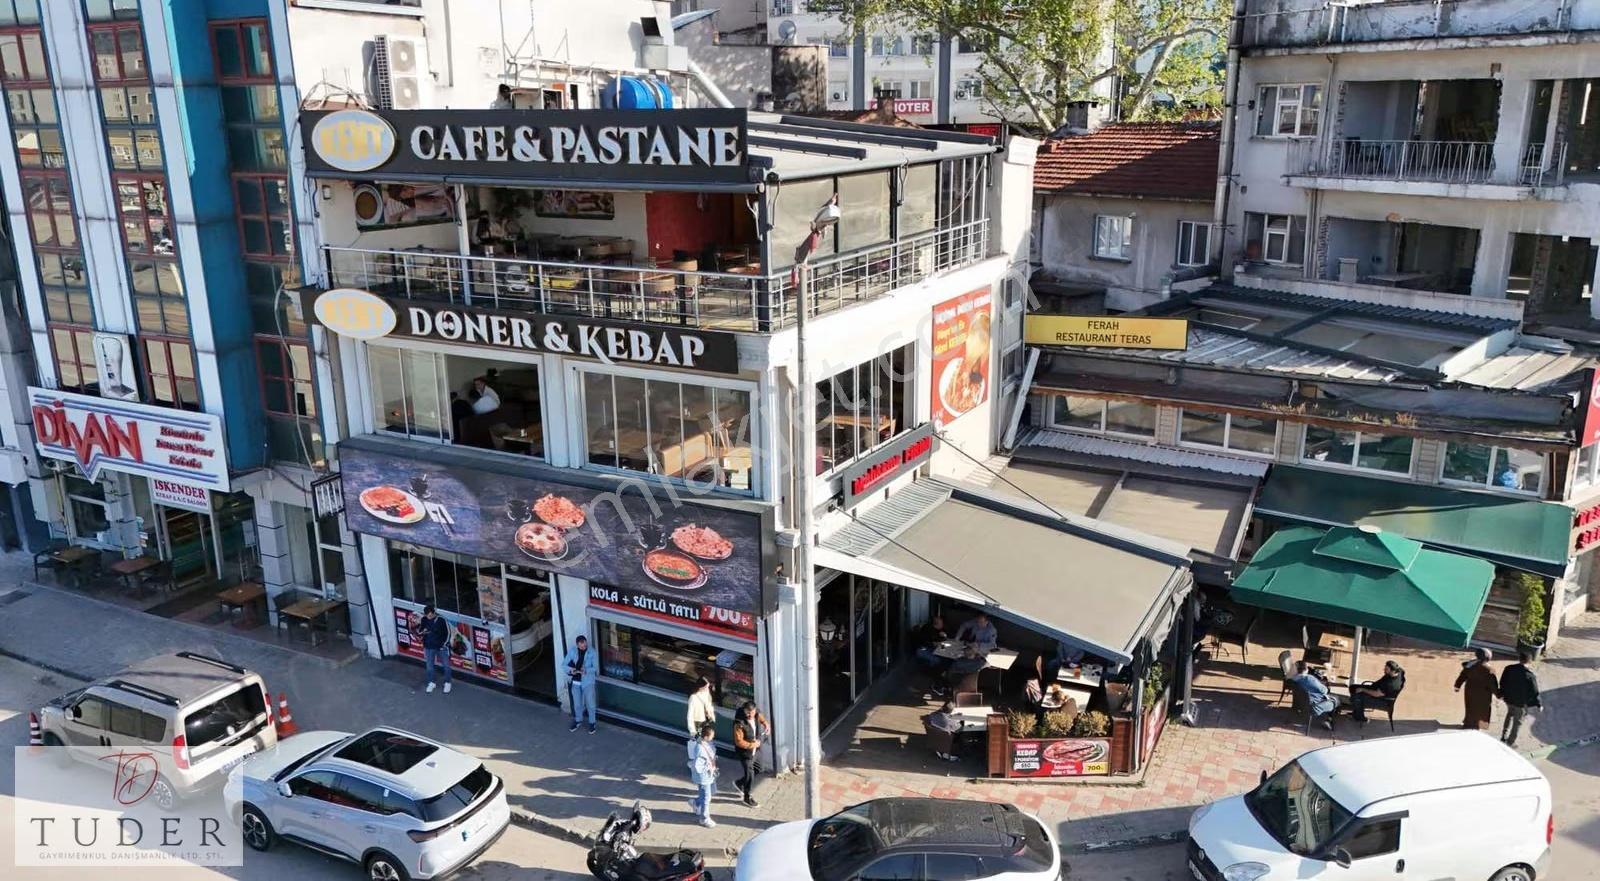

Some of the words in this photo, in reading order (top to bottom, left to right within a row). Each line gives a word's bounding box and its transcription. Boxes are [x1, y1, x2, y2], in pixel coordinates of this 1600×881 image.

[1087, 320, 1120, 330] FERAH
[577, 324, 705, 367] KEBAP
[1056, 332, 1117, 343] RESTAURANT
[1121, 334, 1152, 345] TERAS
[591, 586, 619, 603] KOLA
[622, 594, 630, 605] +
[633, 594, 667, 613] SÜTLÜ
[669, 602, 700, 621] TATLI
